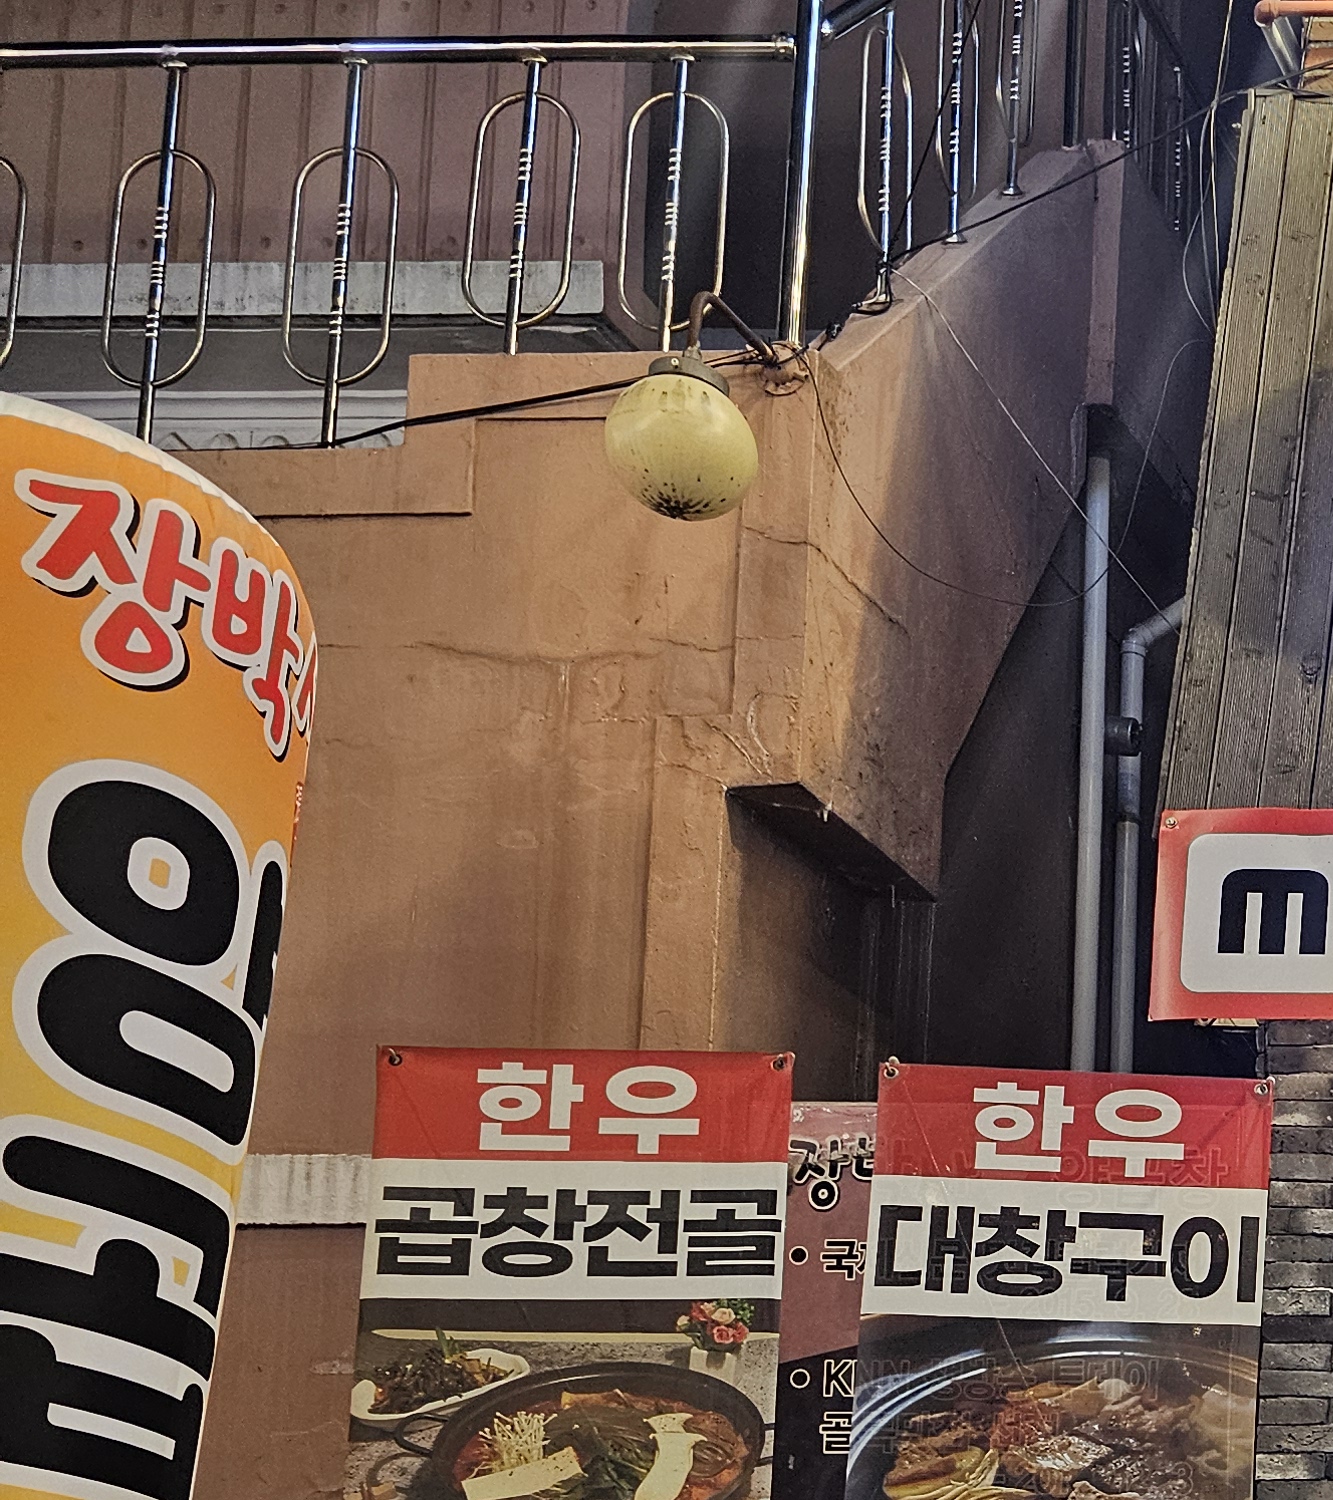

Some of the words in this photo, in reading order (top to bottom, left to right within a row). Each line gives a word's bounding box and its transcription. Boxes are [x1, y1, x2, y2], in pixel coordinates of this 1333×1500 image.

[477, 1061, 701, 1155] 한우
[973, 1082, 1185, 1178] 한우
[374, 1186, 783, 1278] 곱창전골
[821, 1239, 864, 1281] 국
[873, 1204, 1261, 1303] 대창구이
